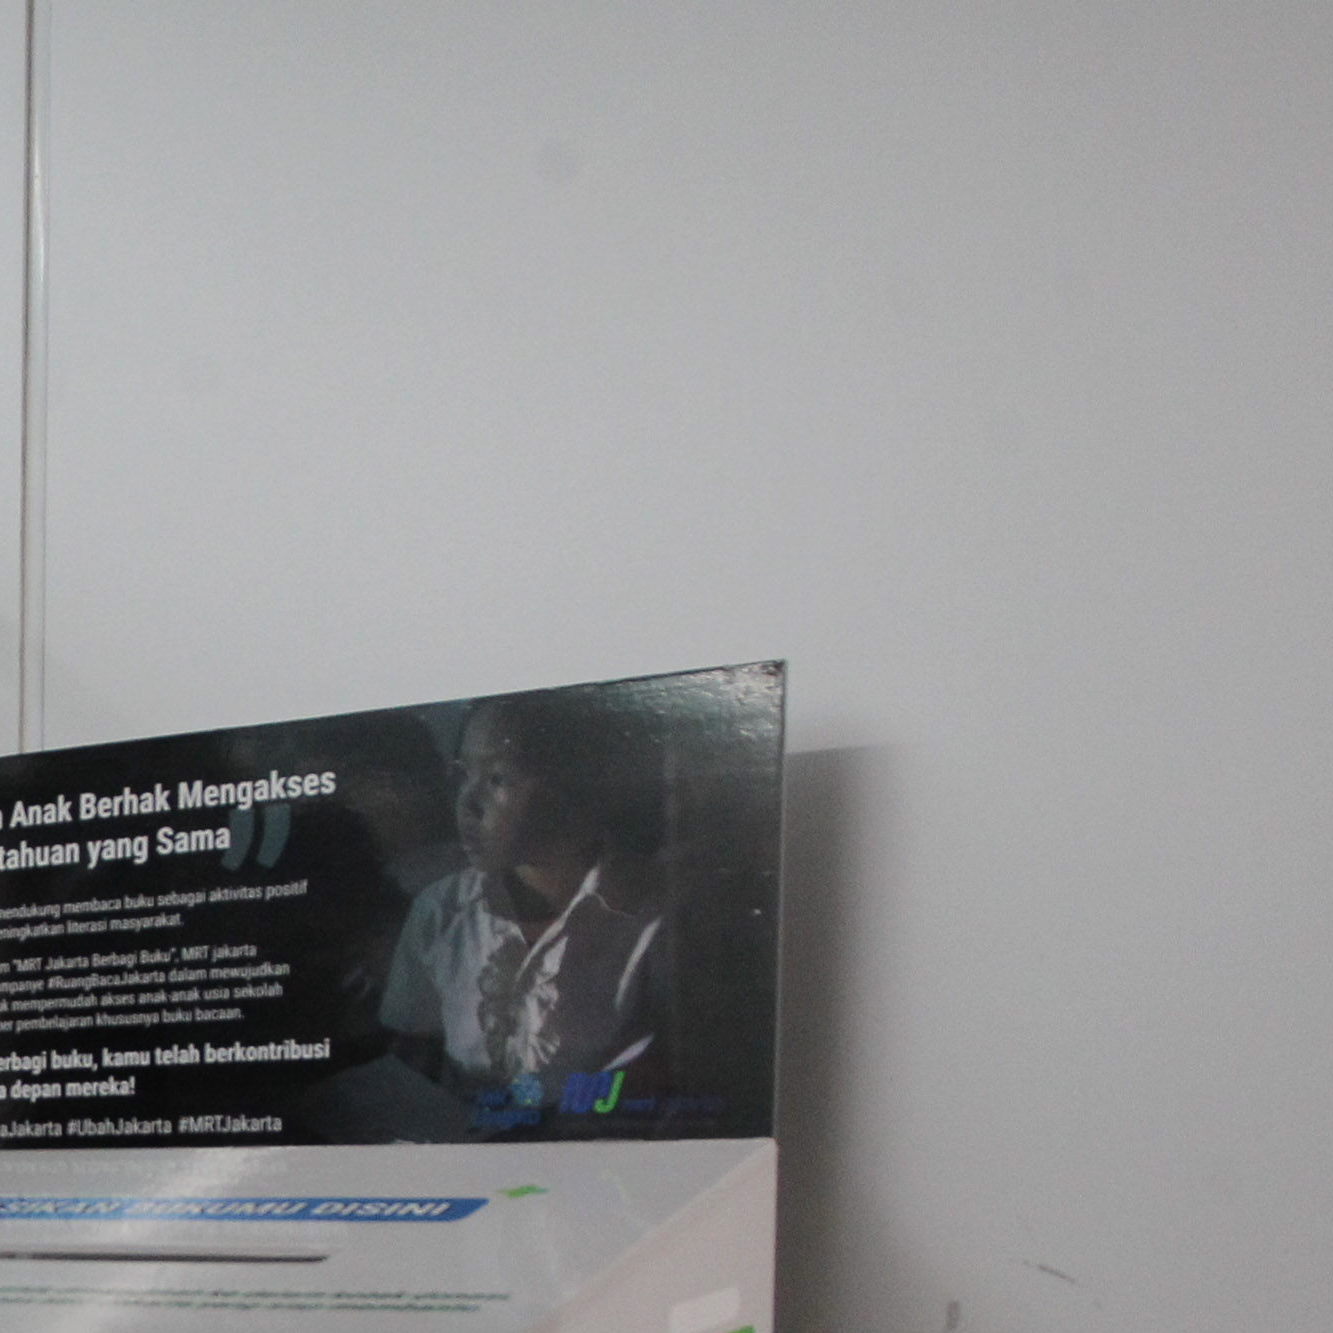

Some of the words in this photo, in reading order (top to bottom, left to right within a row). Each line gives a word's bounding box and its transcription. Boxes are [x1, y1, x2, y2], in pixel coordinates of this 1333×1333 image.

[10, 795, 72, 829] Anak
[79, 784, 171, 820] Berhak
[178, 770, 336, 811] Mengakses
[87, 834, 149, 869] yang
[156, 825, 231, 856] Sama
[63, 897, 122, 913] membaca
[123, 894, 155, 909] buku
[157, 889, 206, 908] sebagai
[209, 885, 263, 902] aktivitas
[266, 879, 308, 900] positif
[66, 919, 107, 933] literasi
[109, 913, 184, 932] masyarakat.
[45, 956, 89, 970] Jakarta
[91, 952, 138, 968] Berbagi
[182, 946, 210, 961] MRT
[168, 968, 207, 982] dalam
[209, 962, 290, 980] mewujudkan
[100, 993, 135, 1006] akses
[234, 982, 283, 998] sekolah
[161, 1009, 193, 1023] buku
[51, 1049, 99, 1071] buku,
[102, 1047, 151, 1068] kamu
[154, 1044, 201, 1066] telah
[203, 1038, 330, 1063] berkontribusi
[10, 1079, 62, 1103] depan
[65, 1076, 135, 1098] mereka!
[66, 1118, 172, 1137] #UbahJakarta
[178, 1114, 283, 1134] #MRTJakarta
[124, 1201, 308, 1216] BUKUMU
[312, 1201, 451, 1217] DISINI
